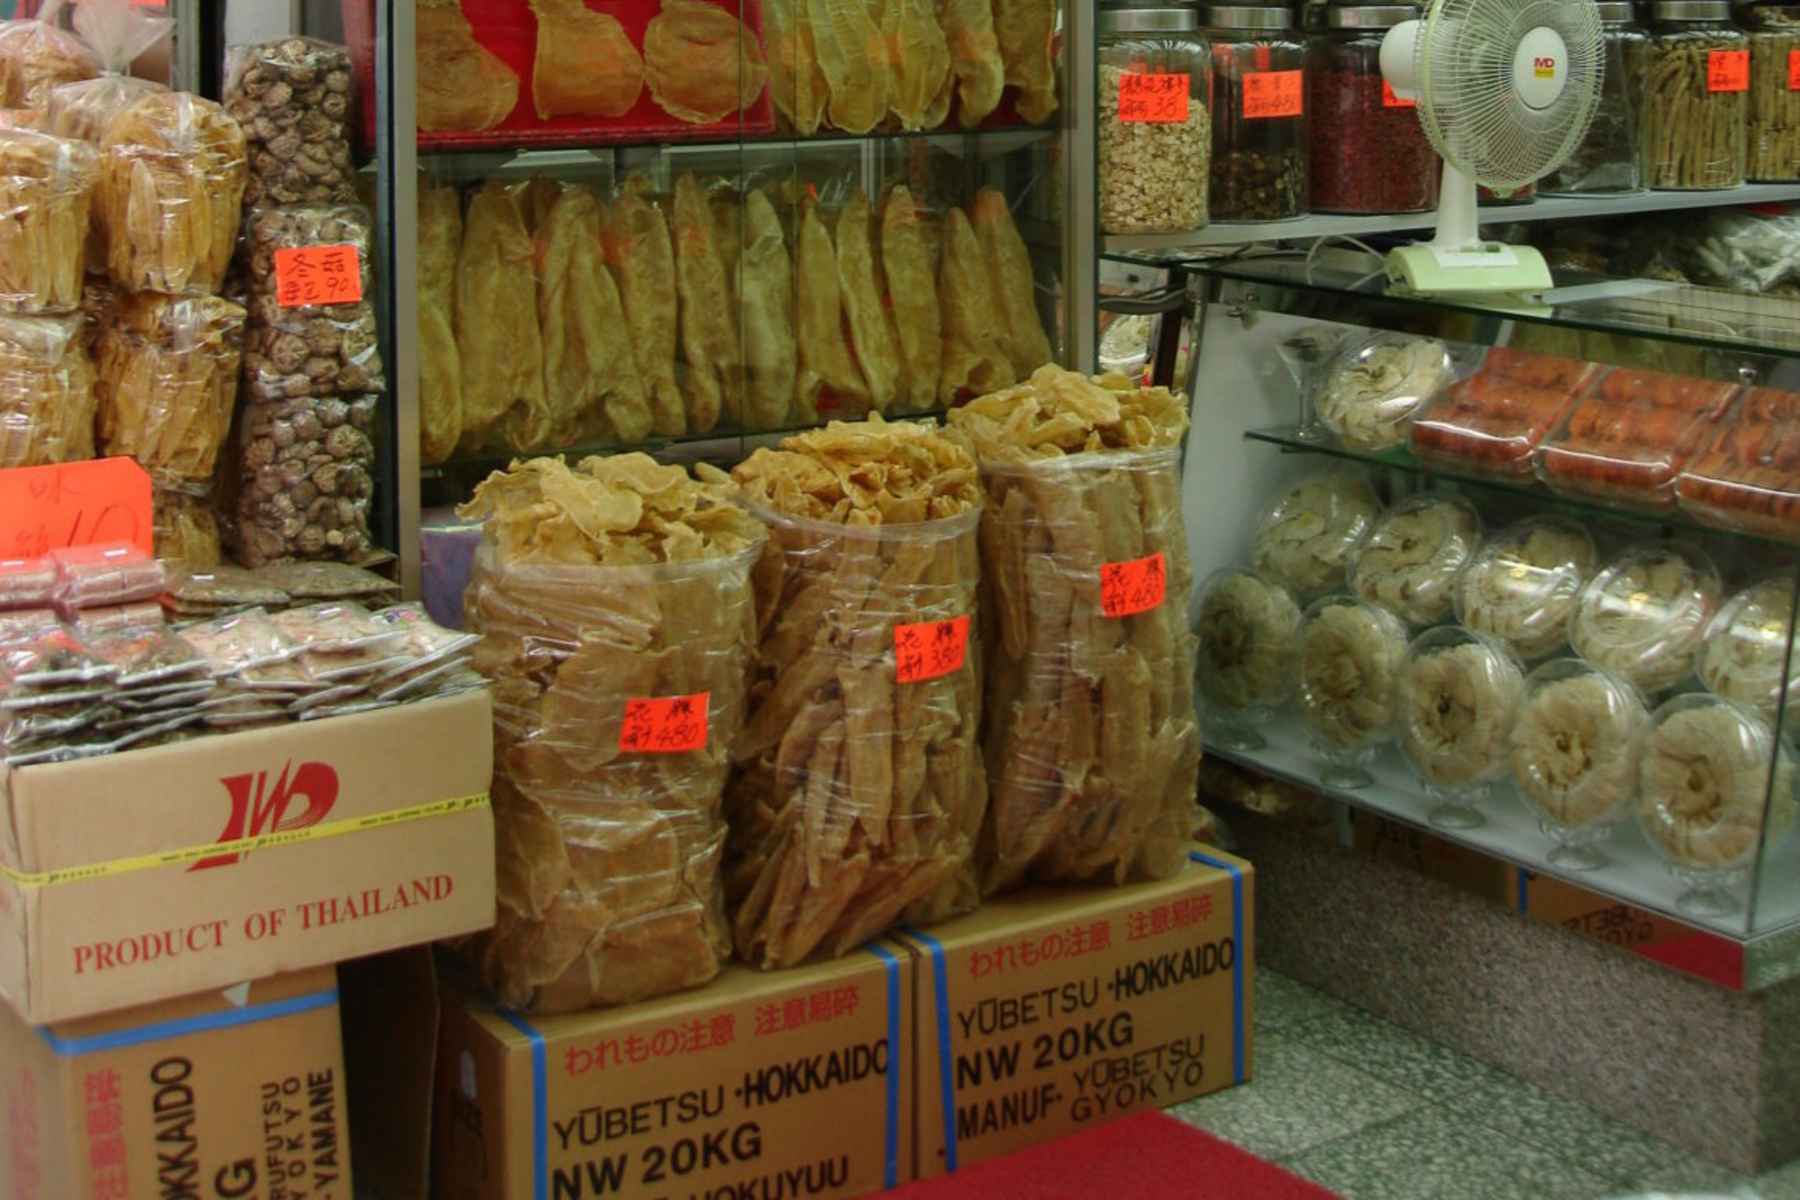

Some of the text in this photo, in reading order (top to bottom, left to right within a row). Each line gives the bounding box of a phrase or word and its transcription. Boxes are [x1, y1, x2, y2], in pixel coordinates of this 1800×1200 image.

[72, 873, 454, 974] PRODUCT OF THAILAND
[957, 1011, 1134, 1090] NW 20KG
[552, 1121, 763, 1200] NW 20KG
